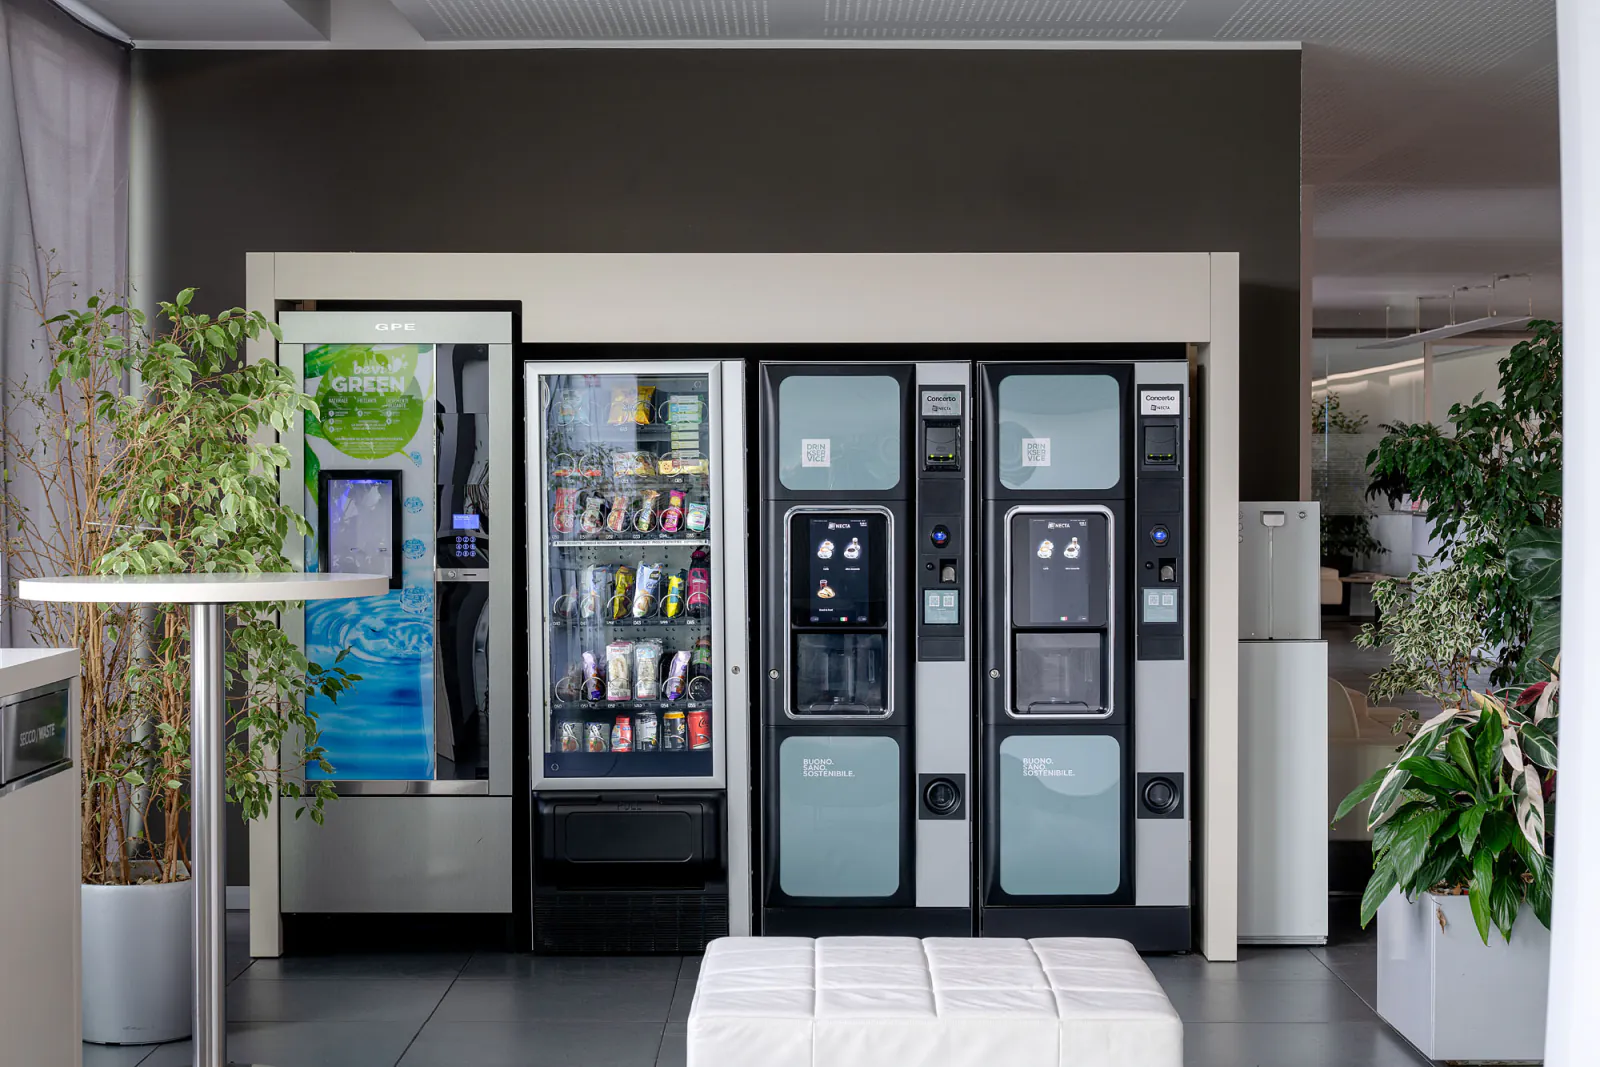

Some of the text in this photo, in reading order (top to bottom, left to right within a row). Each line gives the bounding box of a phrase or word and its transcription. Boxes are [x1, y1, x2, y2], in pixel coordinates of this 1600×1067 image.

[374, 323, 417, 331] GPE
[331, 376, 405, 393] GREEN
[1022, 769, 1076, 777] SOSTENIBILE.
